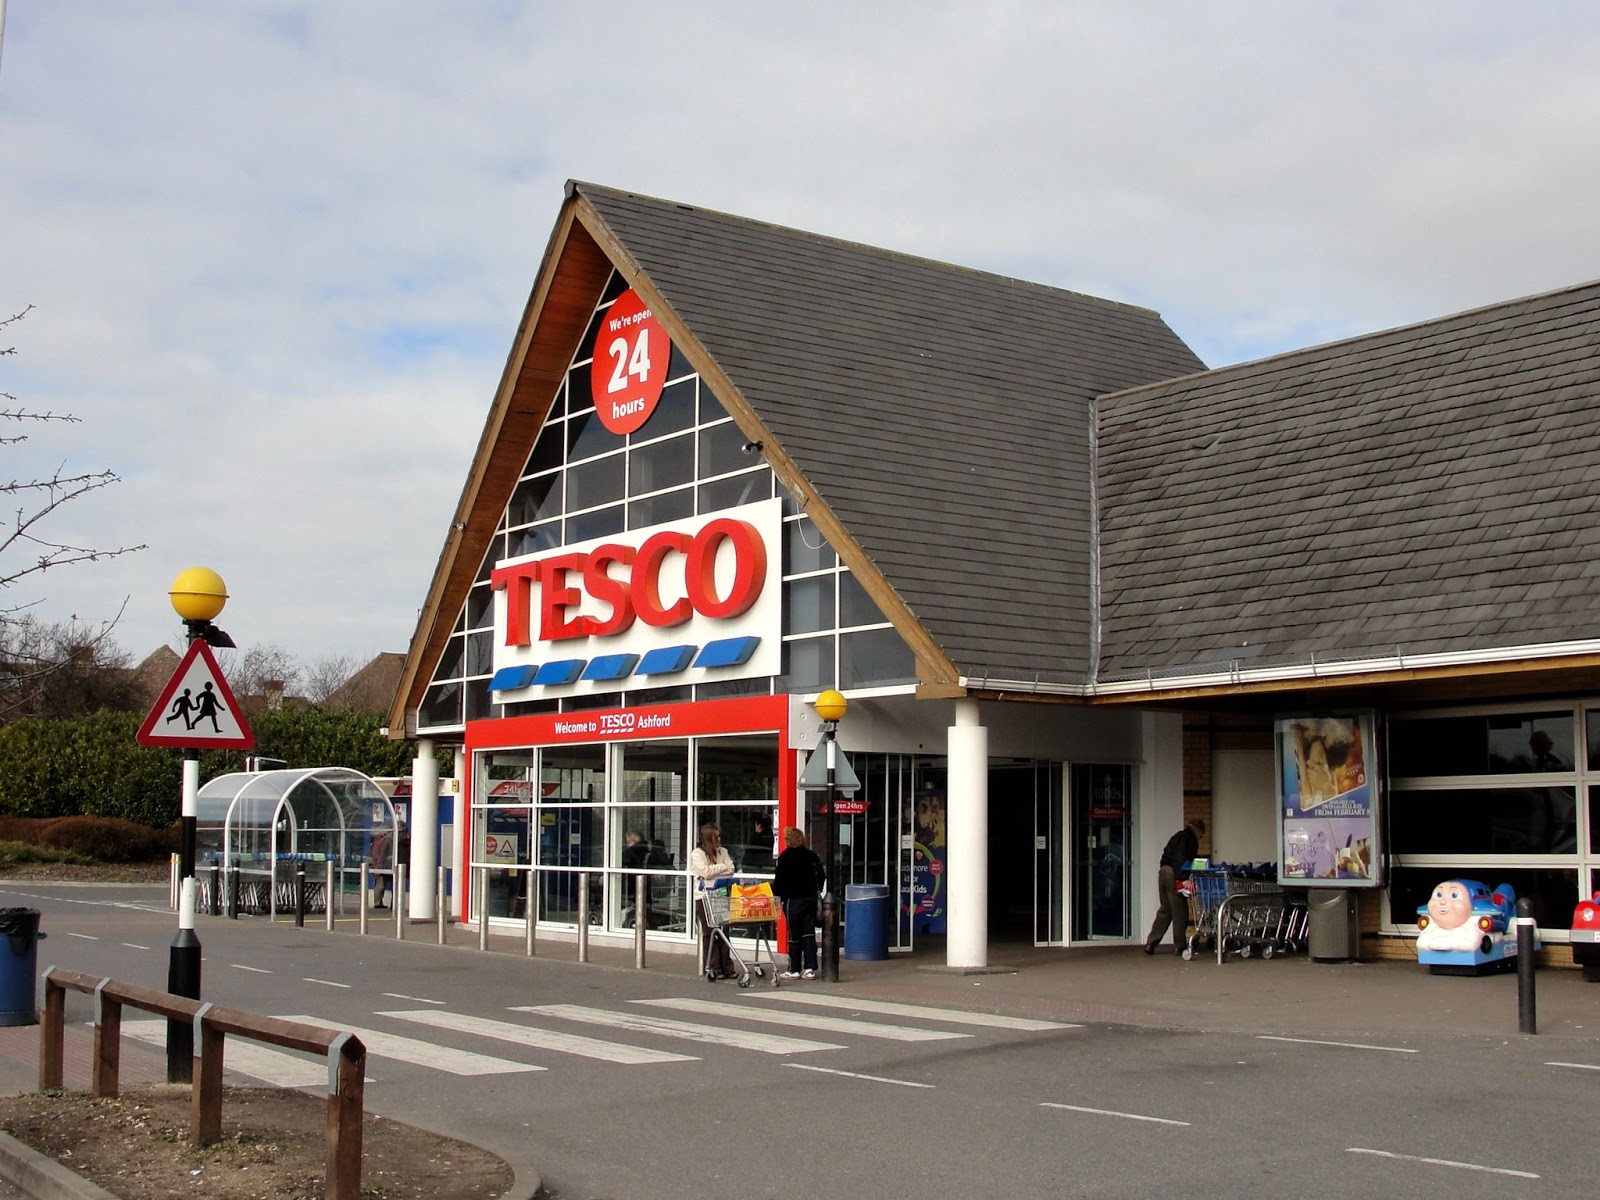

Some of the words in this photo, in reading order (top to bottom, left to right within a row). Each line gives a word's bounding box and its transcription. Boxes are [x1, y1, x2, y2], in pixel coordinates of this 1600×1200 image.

[610, 315, 631, 332] We're
[632, 309, 652, 325] open
[607, 328, 651, 394] 24
[612, 397, 645, 419] hours
[490, 518, 767, 647] TESCO
[554, 721, 587, 735] Welcome
[588, 721, 597, 732] to
[600, 713, 635, 728] TESCO
[637, 713, 671, 728] Ashford
